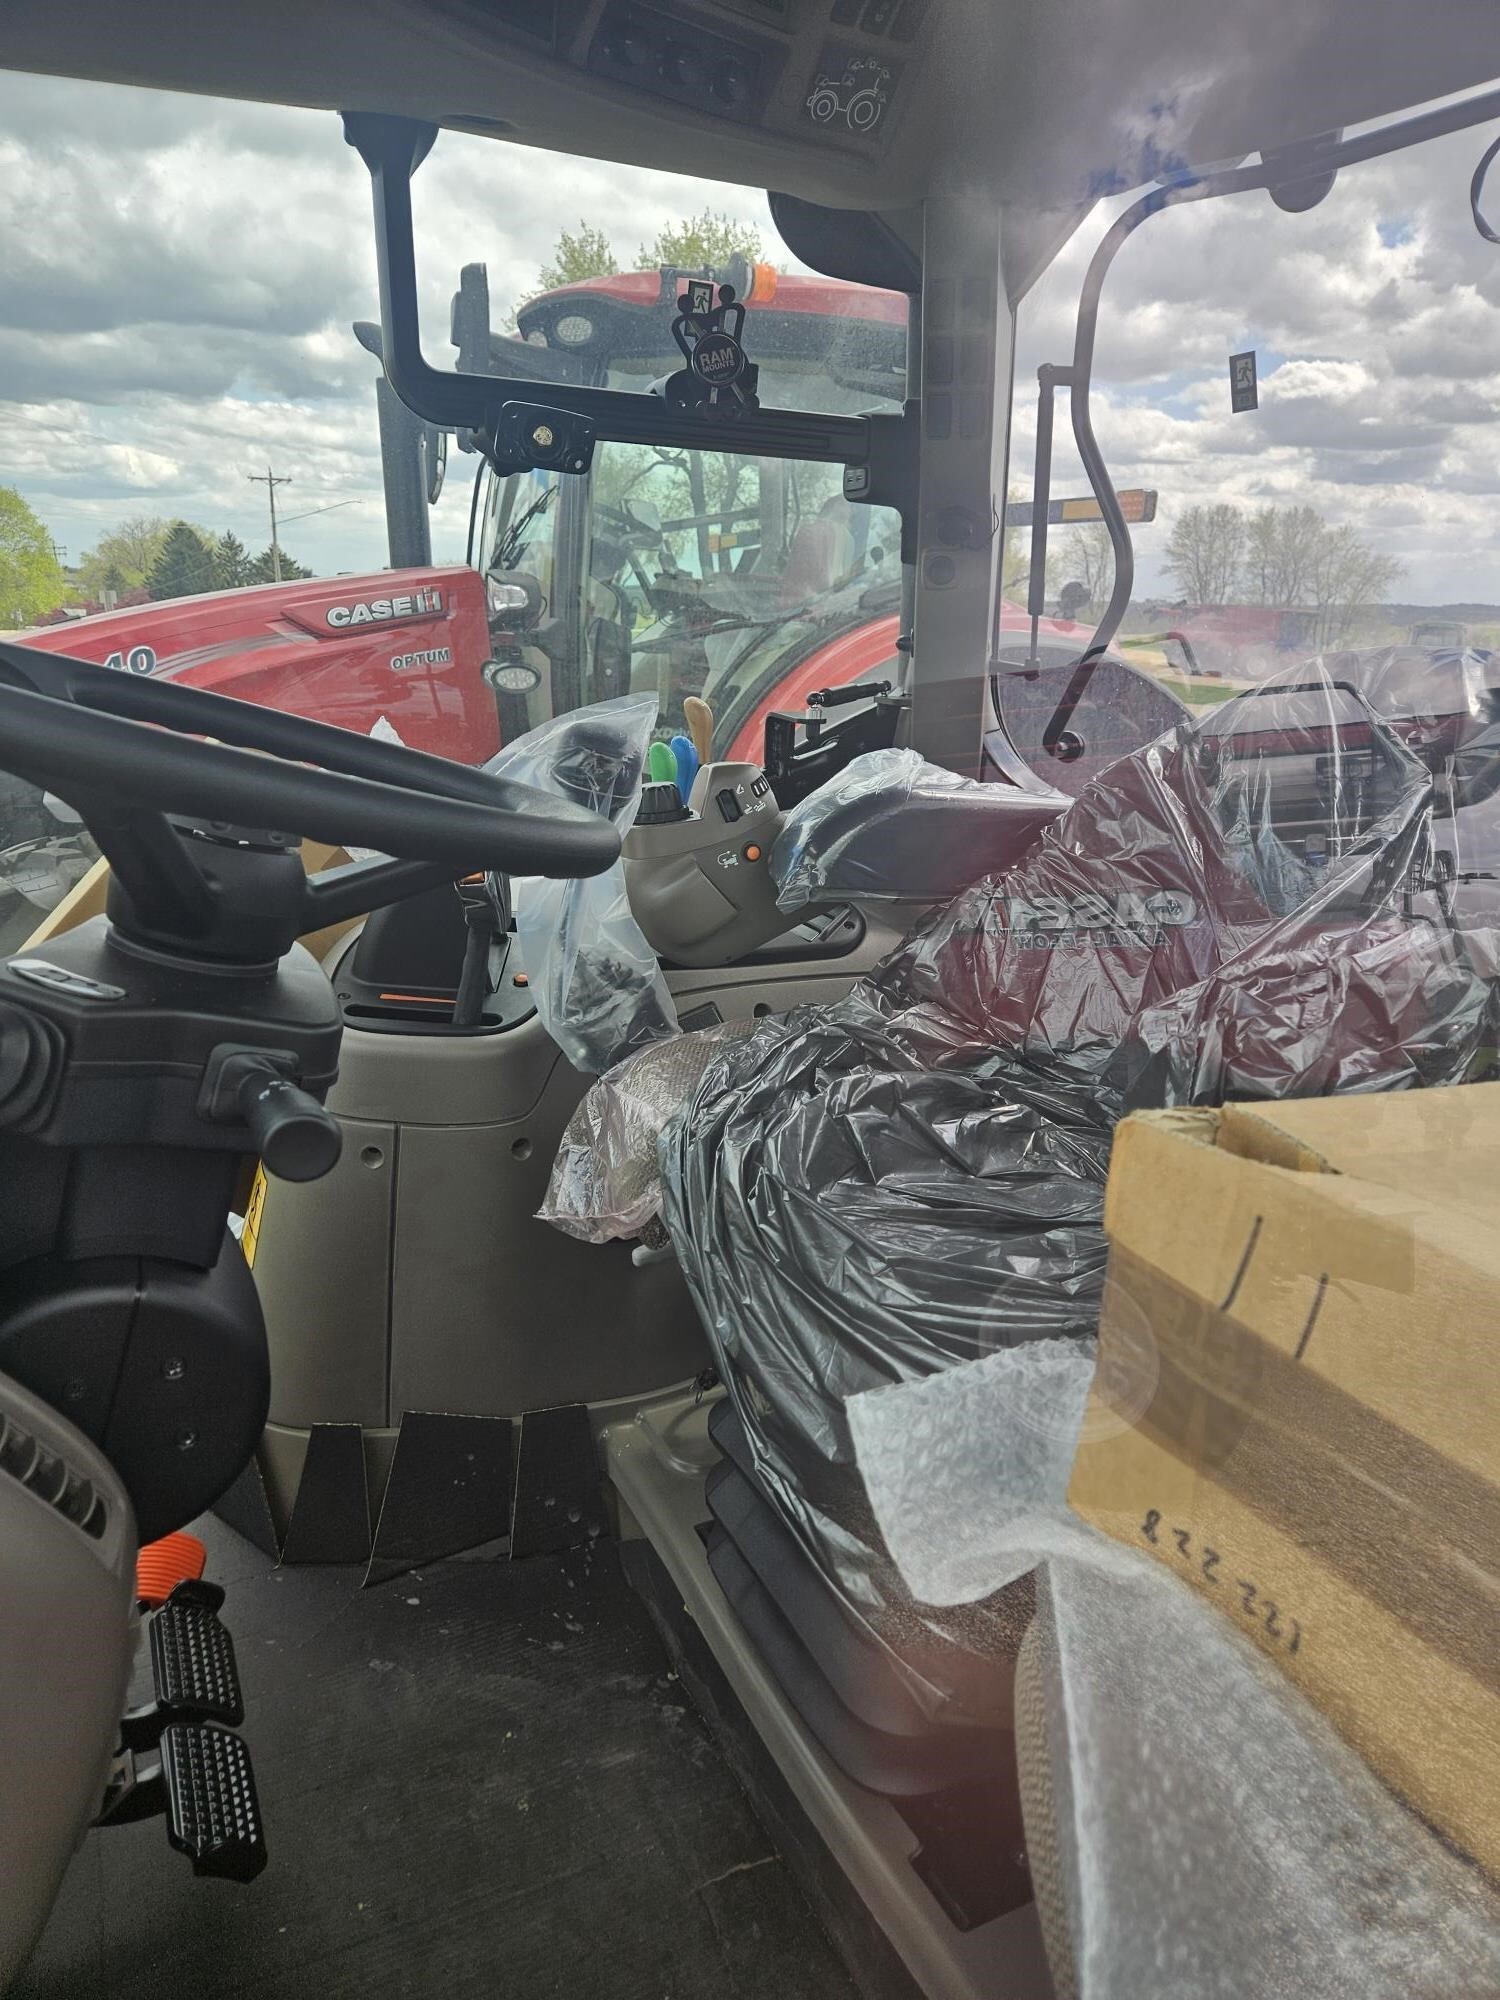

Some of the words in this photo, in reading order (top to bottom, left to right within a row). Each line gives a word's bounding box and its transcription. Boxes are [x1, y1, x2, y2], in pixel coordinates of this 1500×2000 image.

[702, 359, 736, 374] MOUNTS
[327, 596, 413, 628] CASE
[391, 647, 450, 671] OPTUM
